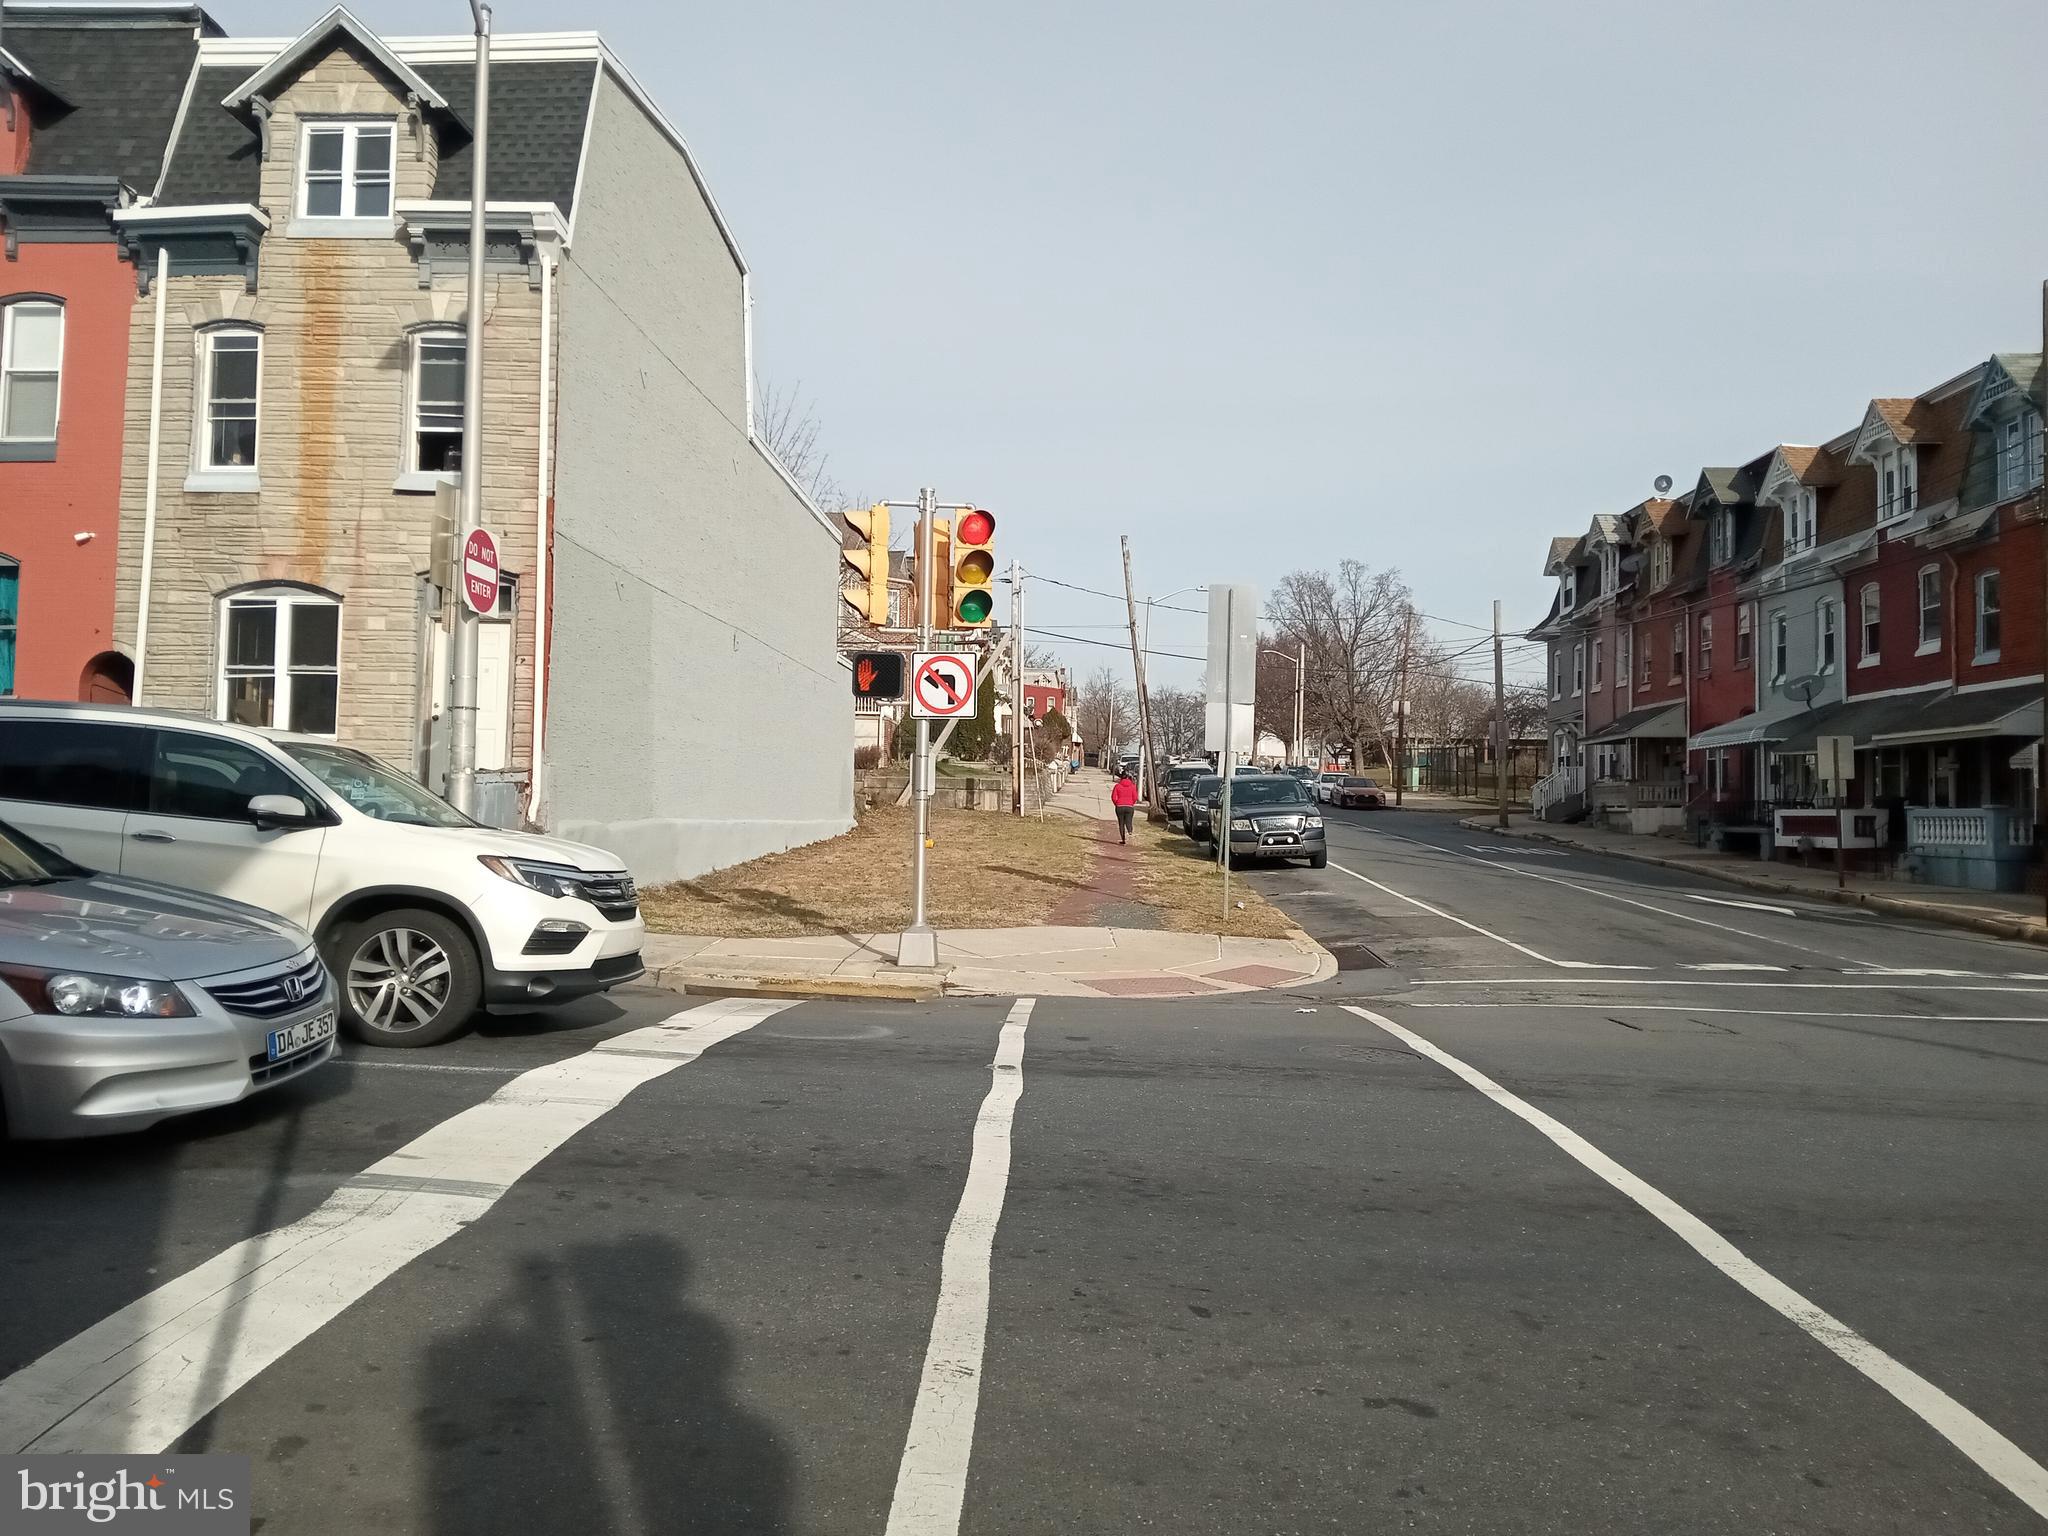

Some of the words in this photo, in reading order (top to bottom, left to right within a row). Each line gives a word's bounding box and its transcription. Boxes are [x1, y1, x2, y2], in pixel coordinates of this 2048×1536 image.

[468, 541, 478, 556] DO
[481, 546, 495, 564] NOT
[470, 579, 491, 599] ENTER
[277, 1030, 295, 1054] DA
[301, 1021, 316, 1044] JE
[316, 1012, 334, 1037] 357
